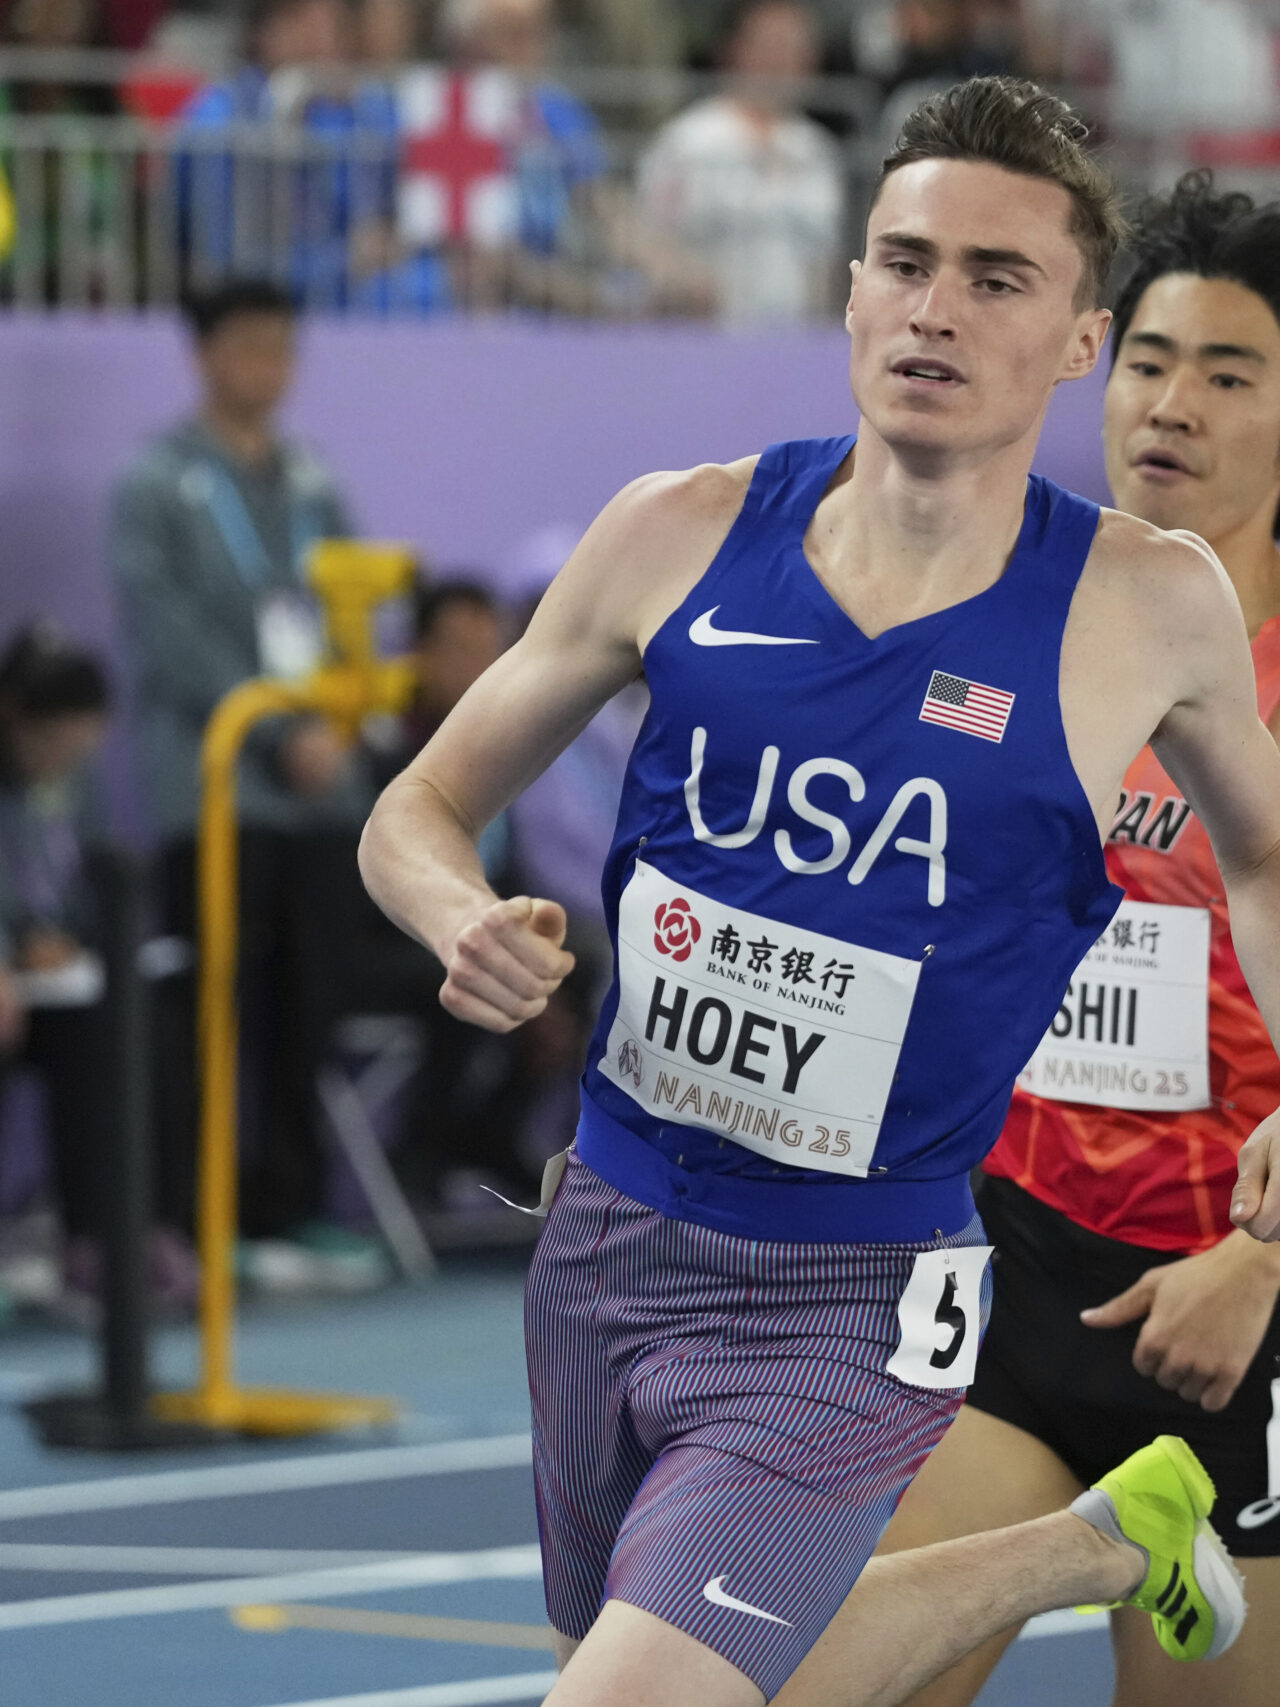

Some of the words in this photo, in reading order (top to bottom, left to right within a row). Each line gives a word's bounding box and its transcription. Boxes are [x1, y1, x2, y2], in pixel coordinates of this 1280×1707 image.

[684, 727, 947, 906] USA
[1109, 791, 1191, 850] AN
[707, 962, 746, 985] BANK
[753, 978, 771, 993] OF
[777, 982, 846, 1016] NANJING
[710, 924, 855, 998] 南京银行
[645, 975, 826, 1094] HOEY
[653, 1071, 803, 1148] NANJING
[808, 1125, 852, 1157] 25
[1043, 1057, 1147, 1093] NANJING
[1154, 1071, 1189, 1096] 25
[929, 1271, 966, 1369] 5
